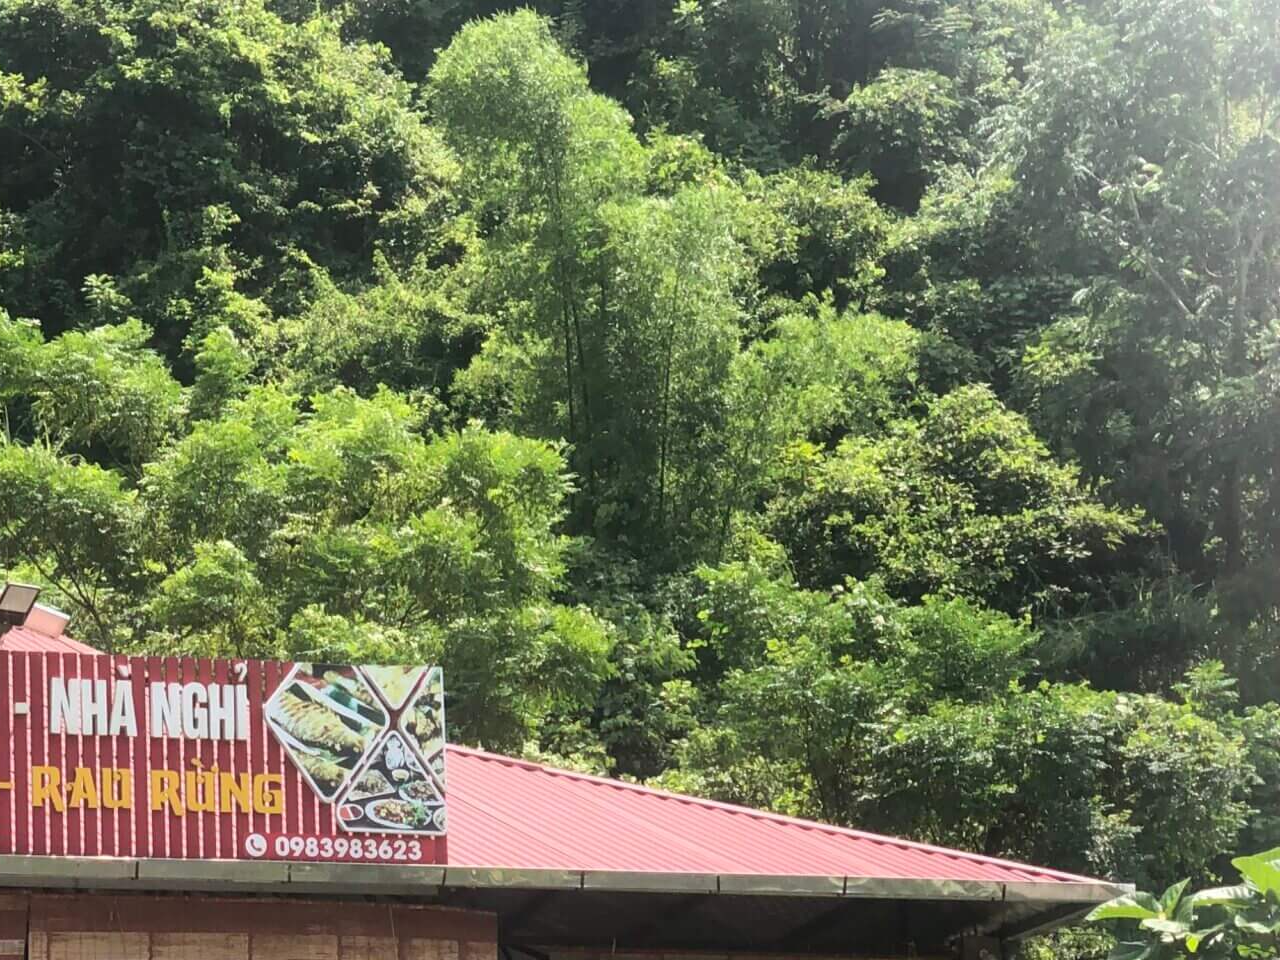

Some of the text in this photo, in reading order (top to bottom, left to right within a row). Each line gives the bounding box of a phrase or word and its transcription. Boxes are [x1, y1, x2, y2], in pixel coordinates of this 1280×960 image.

[50, 664, 138, 737] NHÀ
[150, 662, 250, 740] NGHỈ
[31, 764, 133, 812] RAU
[274, 835, 423, 861] 0983983623
